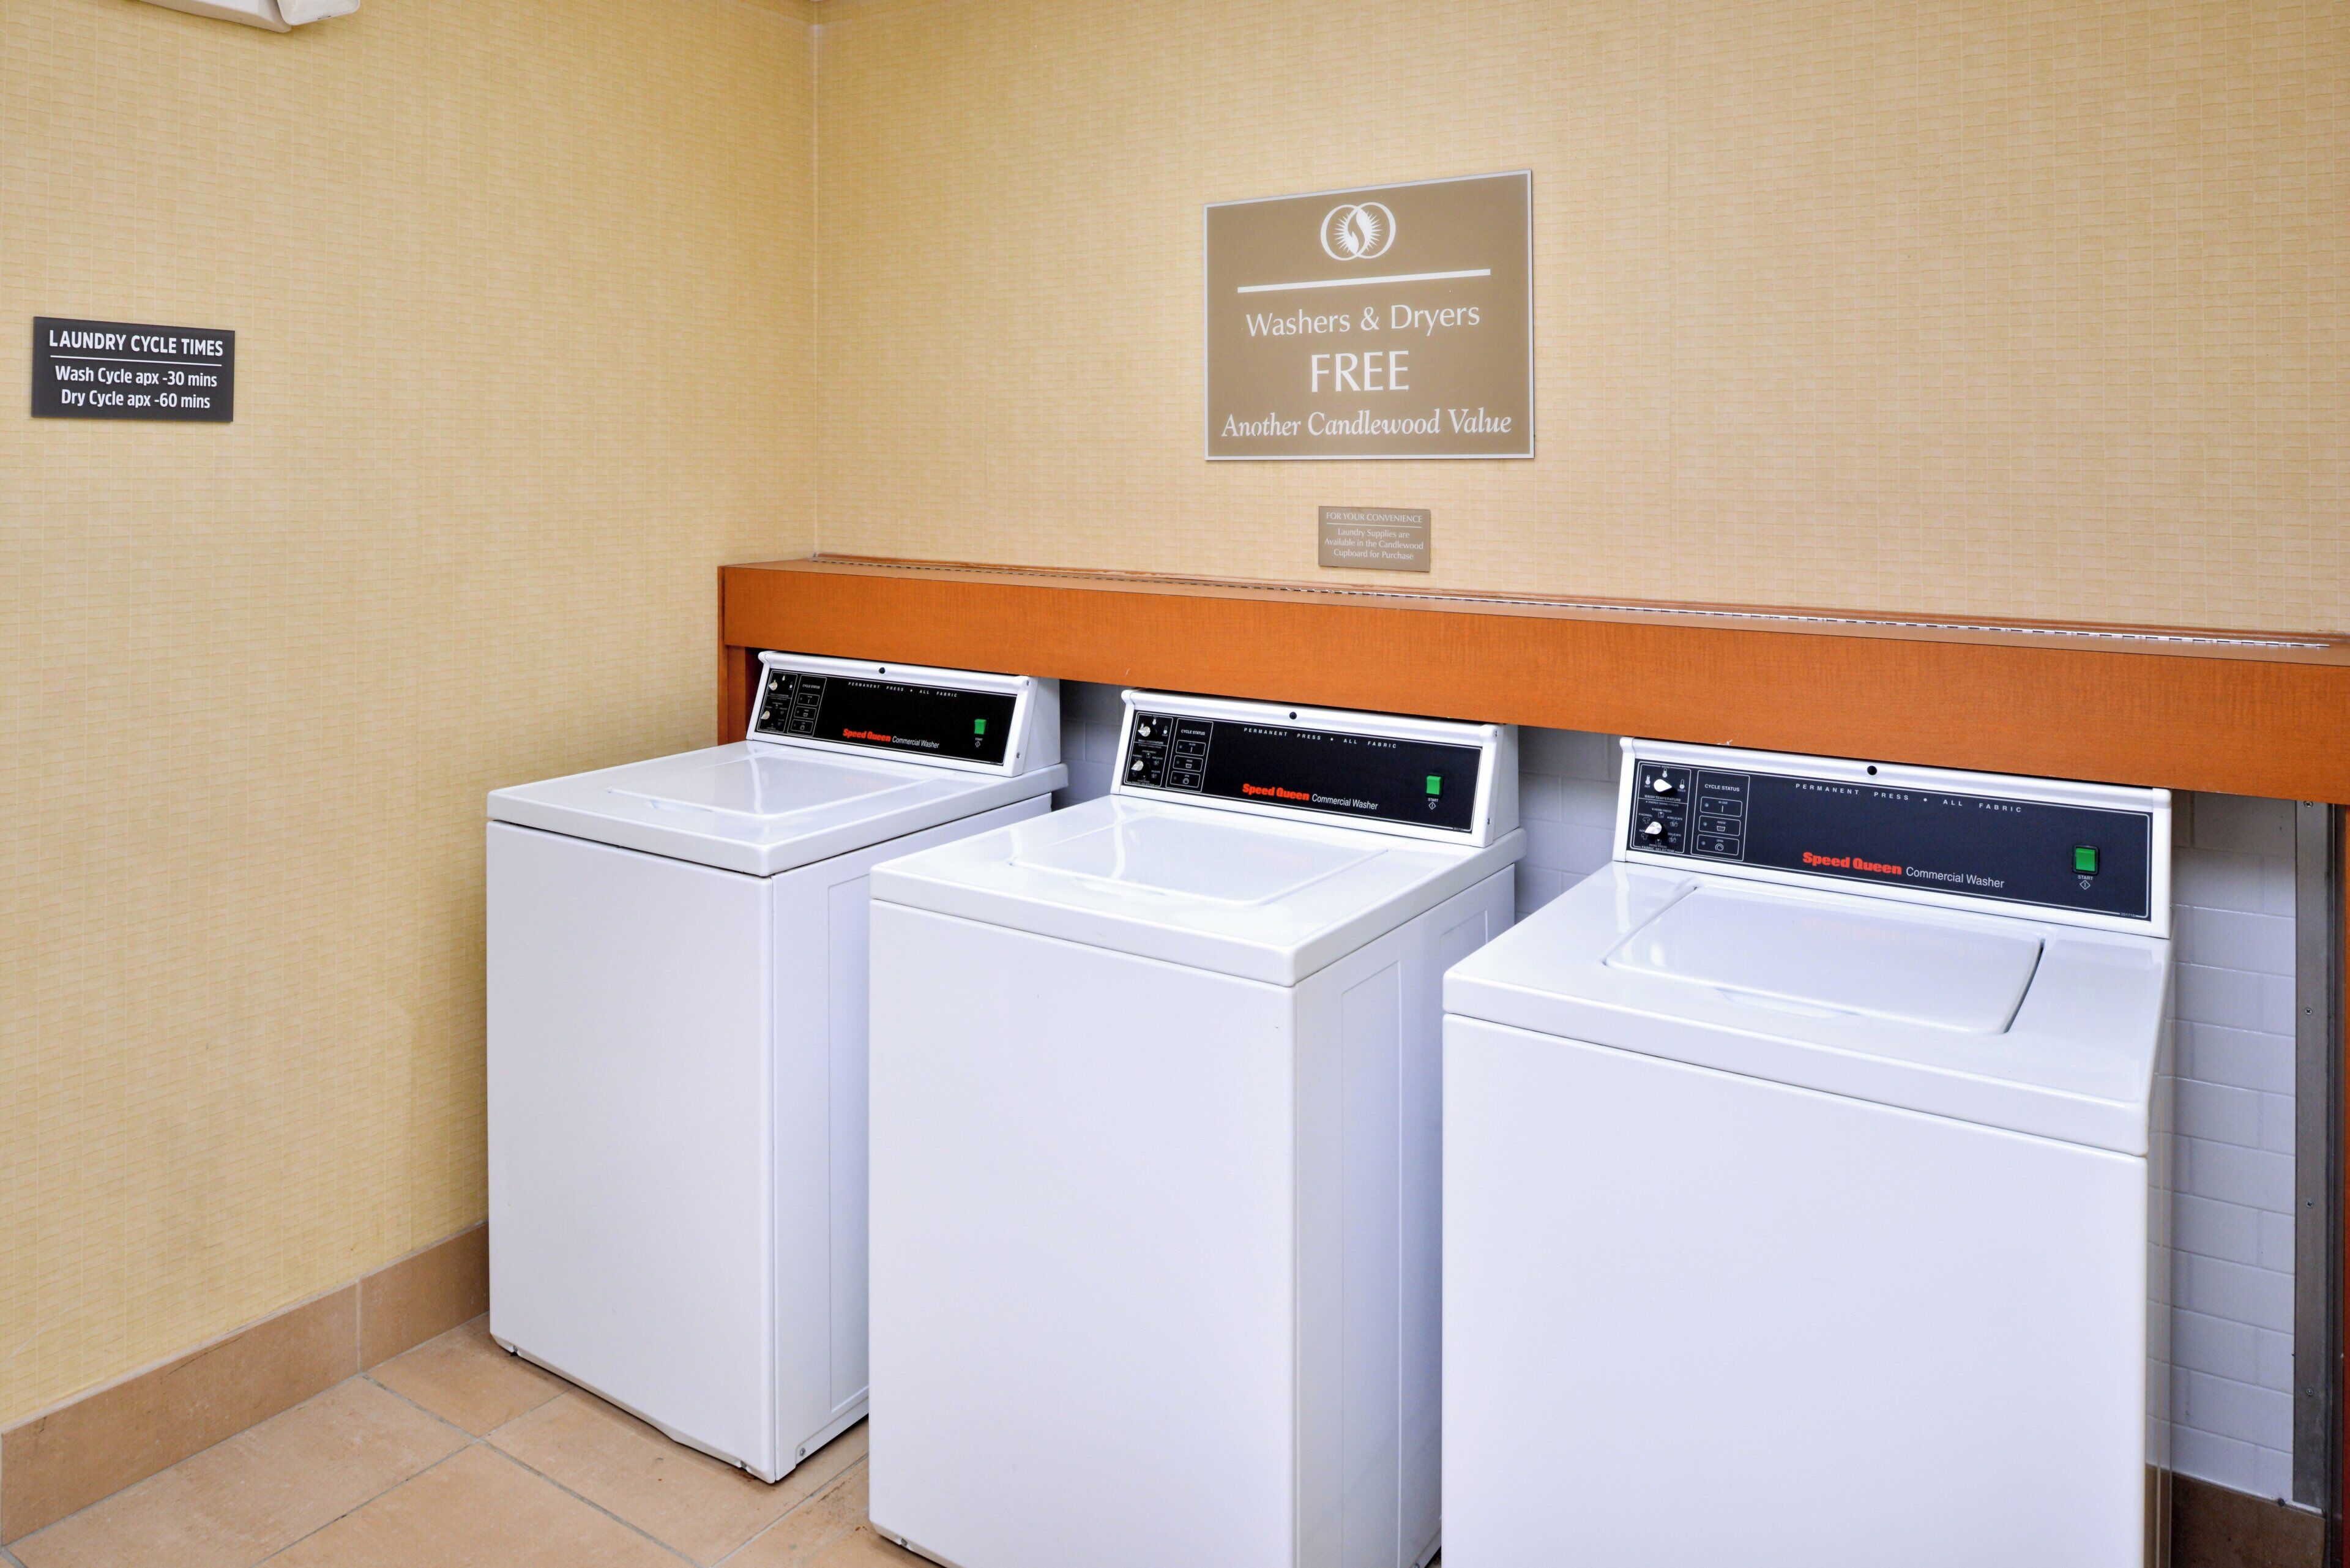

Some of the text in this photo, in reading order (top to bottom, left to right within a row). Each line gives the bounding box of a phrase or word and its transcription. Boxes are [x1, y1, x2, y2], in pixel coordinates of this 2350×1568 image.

[1245, 304, 1480, 337] Washers & Dryers
[50, 330, 223, 357] LAUNDRY CYCLE TIMES
[55, 365, 217, 387] Wash Cycle apx -30 mins
[1311, 350, 1409, 393] FREE
[61, 389, 211, 409] Dry Cycle apx -60 mins
[1221, 407, 1512, 437] Another Candlewood Value
[1367, 513, 1422, 523] CONVENIENCE
[1338, 528, 1365, 538] Laundry
[1367, 529, 1397, 539] Supplies
[1334, 548, 1368, 559] Cupboard
[1382, 551, 1414, 560] Purchase
[1378, 540, 1424, 550] Candlewood
[843, 728, 939, 749] Speed Queen Commercial Washer
[1244, 727, 1288, 736] PERMANENT
[1242, 783, 1378, 810] Speed Queen Commercial Washer
[1796, 783, 1860, 795] PERMANENT
[1874, 791, 1909, 801] PRESS
[1979, 803, 2021, 813] FABRIC
[1802, 852, 2005, 889] Speed Queen Commercial Washer
